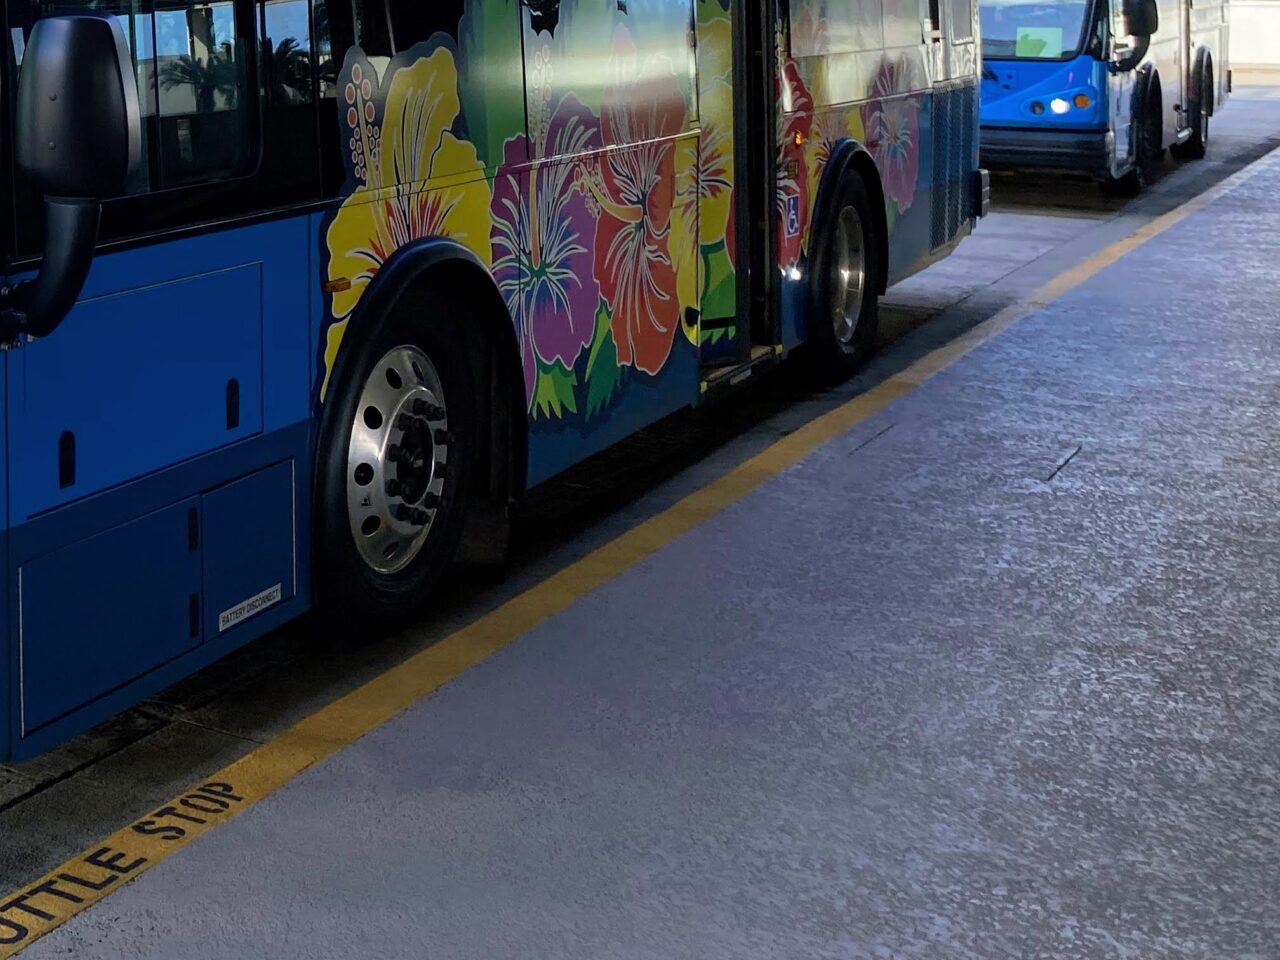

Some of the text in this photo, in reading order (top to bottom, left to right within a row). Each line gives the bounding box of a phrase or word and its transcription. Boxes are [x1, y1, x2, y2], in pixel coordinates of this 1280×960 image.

[221, 588, 279, 627] BATTERY DISCONNECT
[131, 781, 245, 841] STOP
